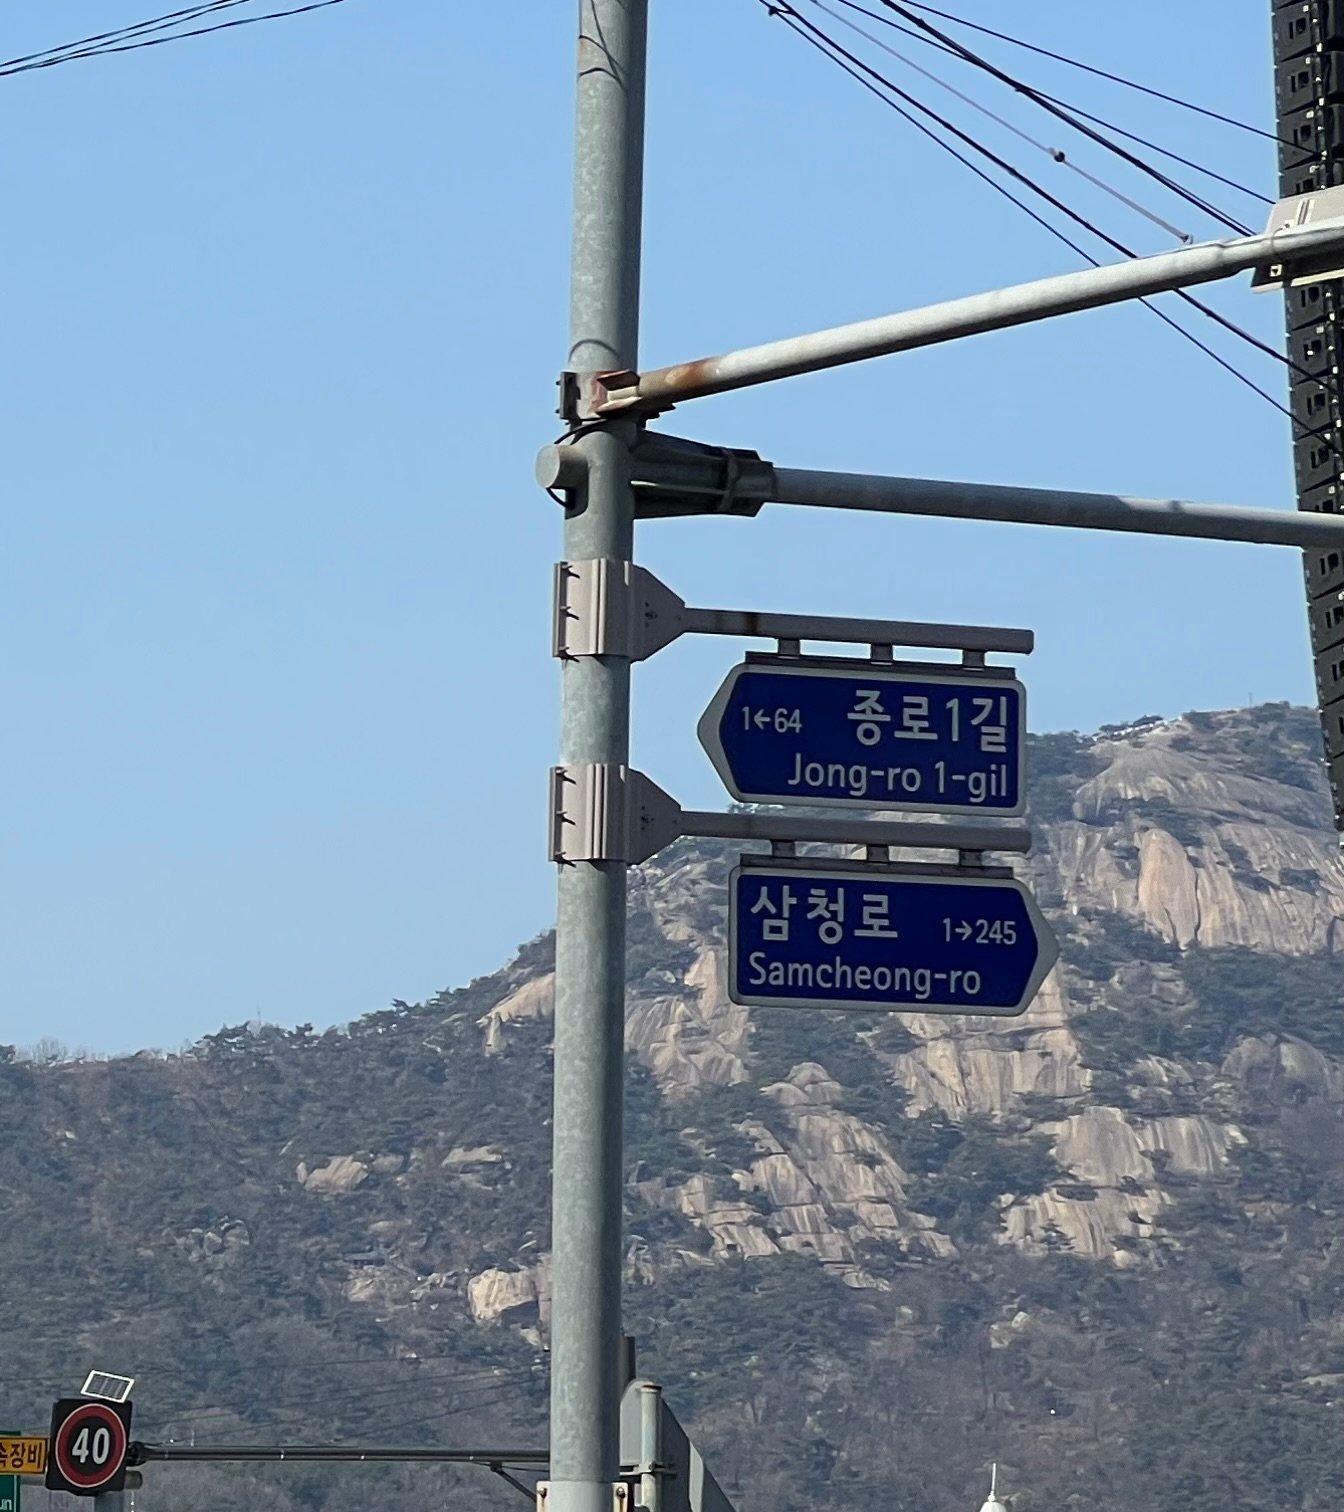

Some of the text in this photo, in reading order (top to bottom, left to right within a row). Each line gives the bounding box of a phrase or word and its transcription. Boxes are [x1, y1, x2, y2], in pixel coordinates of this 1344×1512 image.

[774, 709, 803, 734] 64
[847, 689, 1007, 753] 종로1길
[788, 753, 1008, 802] Jong-ro 1-gil
[750, 886, 899, 945] 삼청로
[976, 920, 1017, 945] 245
[748, 951, 981, 998] Samcheong-ro
[71, 1427, 111, 1465] 40
